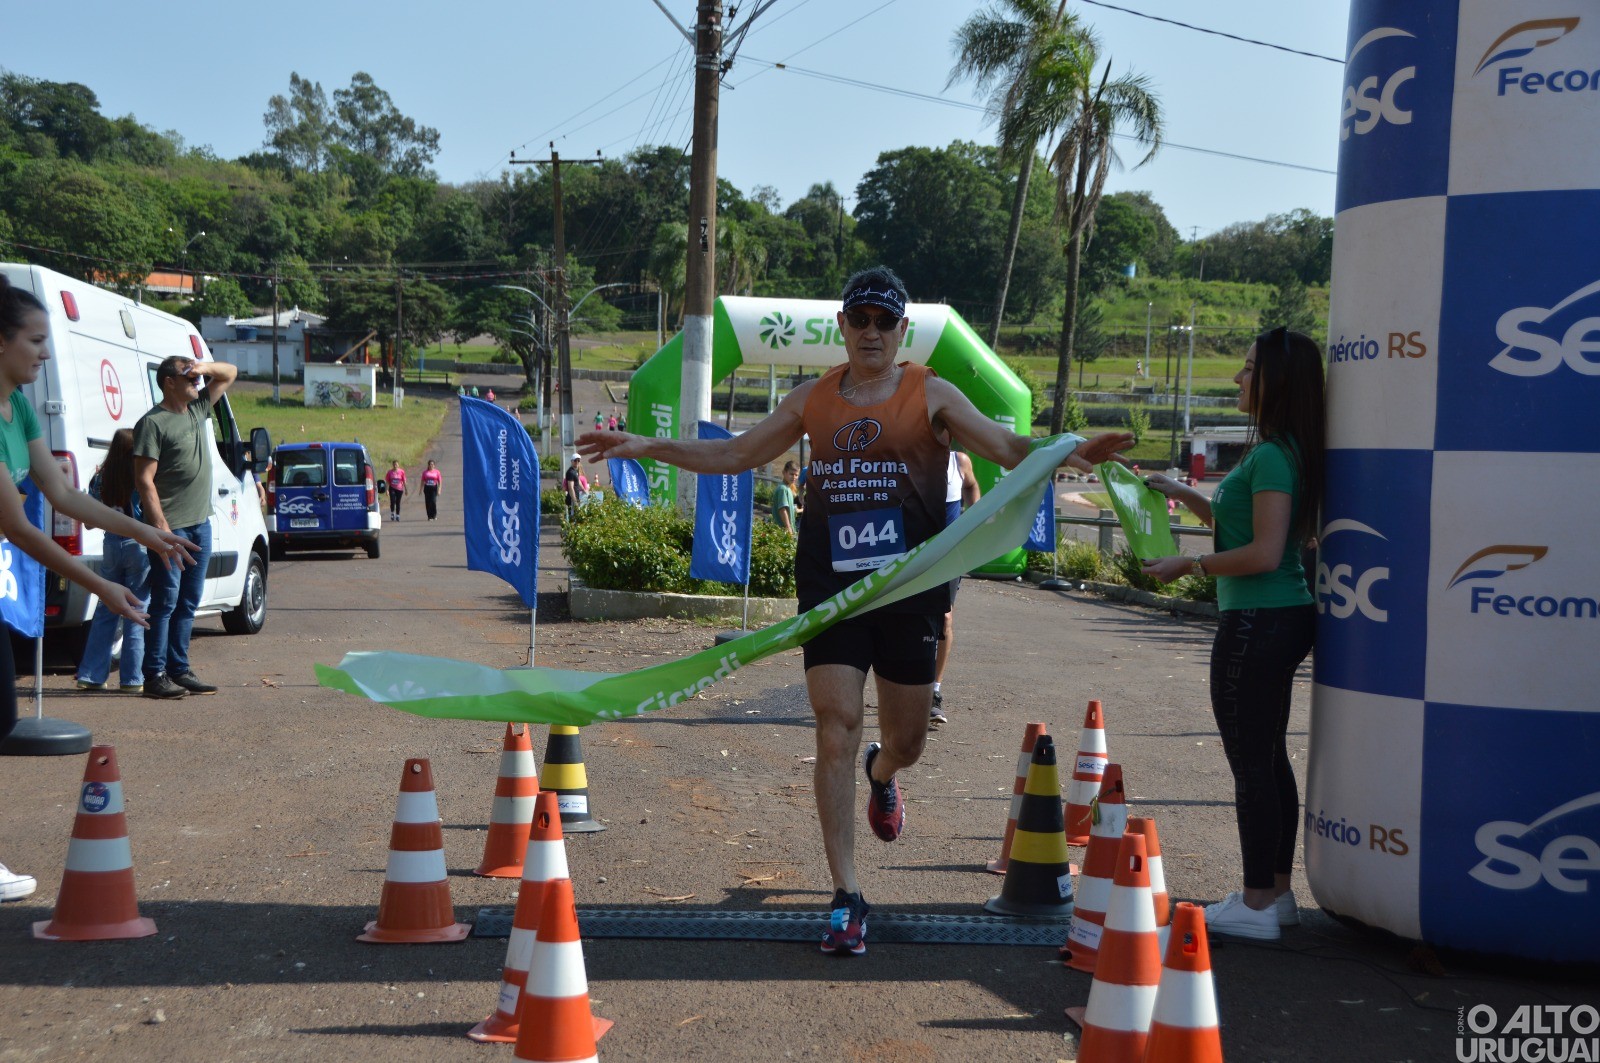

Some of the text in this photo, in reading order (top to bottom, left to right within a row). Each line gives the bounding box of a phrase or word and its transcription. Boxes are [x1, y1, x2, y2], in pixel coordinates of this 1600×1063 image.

[802, 318, 916, 348] Sici
[1387, 331, 1427, 359] RS
[497, 429, 508, 490] Fecomércio
[649, 403, 673, 492] Siedi
[511, 458, 520, 491] Senac
[811, 458, 909, 476] Med Forma
[821, 477, 897, 490] Academia
[830, 493, 865, 503] SEBERI
[873, 493, 889, 501] RS
[278, 502, 314, 514] Sesc
[500, 500, 522, 567] Sesc
[717, 510, 737, 567] Sesc
[838, 520, 899, 550] 044
[1470, 586, 1600, 618] Fecom
[1369, 824, 1409, 856] RS
